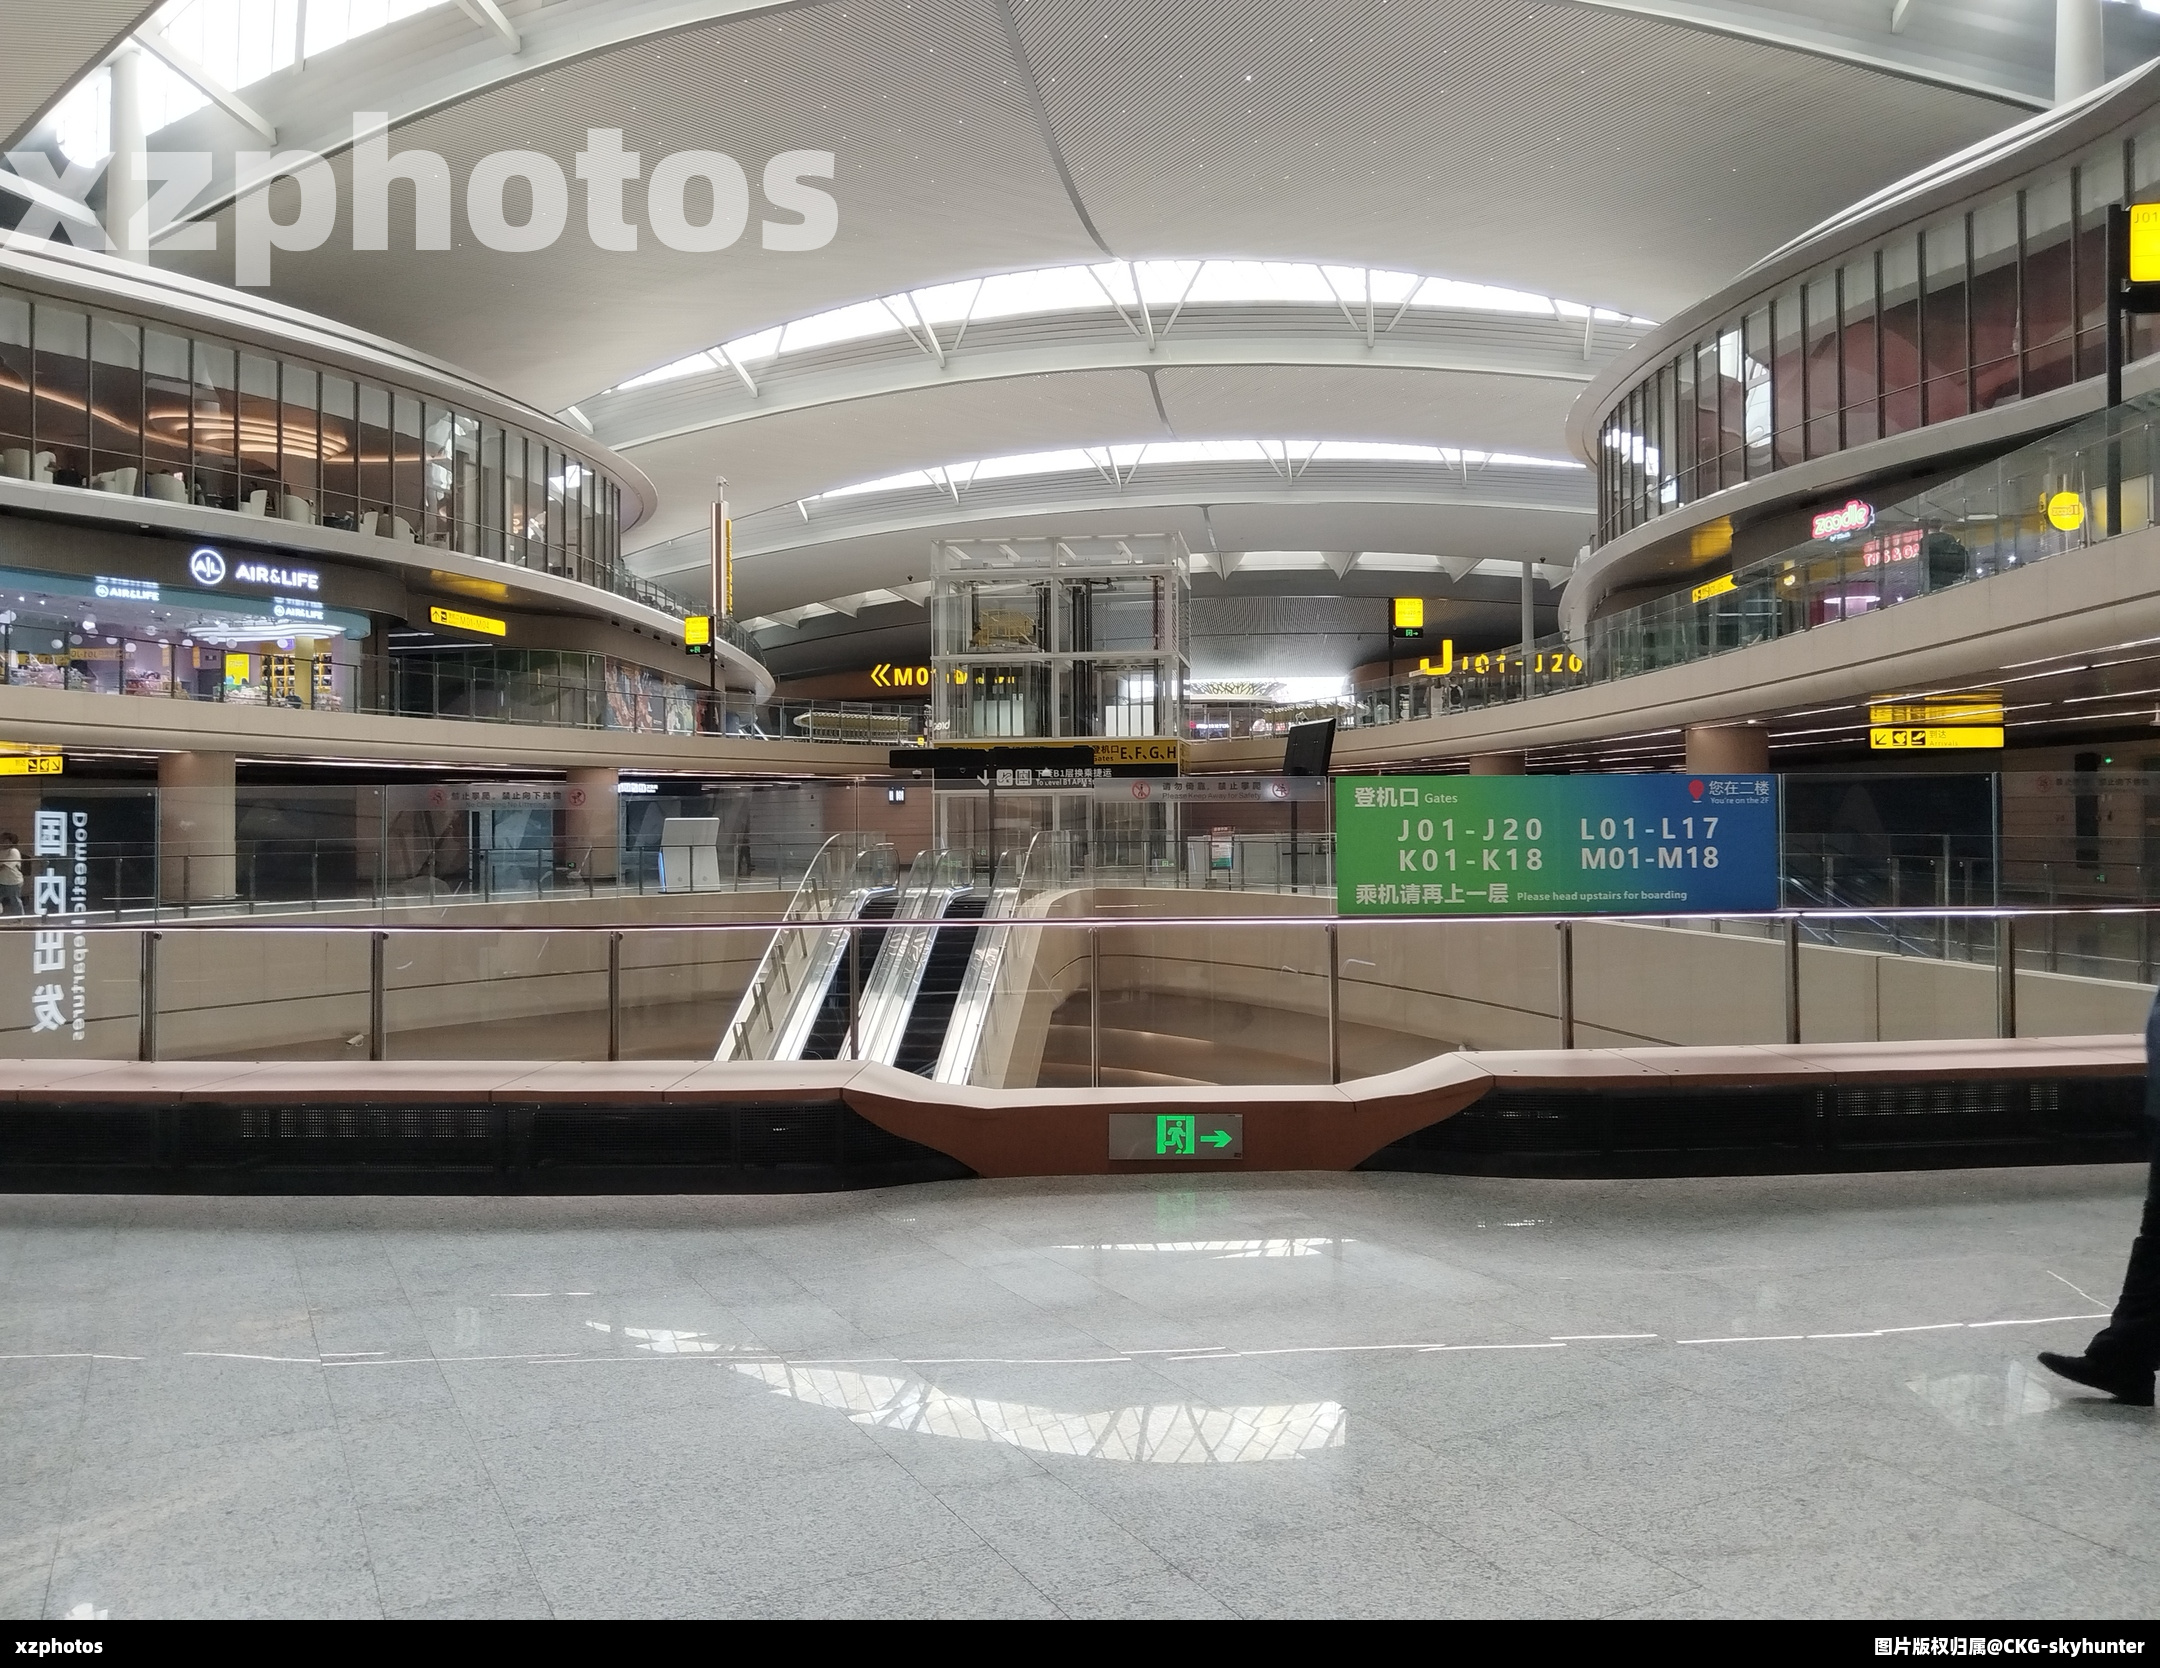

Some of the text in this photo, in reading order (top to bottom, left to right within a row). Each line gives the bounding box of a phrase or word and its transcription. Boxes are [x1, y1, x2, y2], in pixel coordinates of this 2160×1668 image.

[1814, 504, 1867, 535] zoodle
[235, 564, 319, 590] AIR&LIFE
[109, 587, 160, 602] AIR&LIFE
[284, 607, 324, 621] AIR&LIFE
[1419, 639, 1453, 676] J
[1929, 730, 1947, 739] 到达
[1035, 768, 1112, 778] 下B1层换乘捷运
[1188, 793, 1207, 801] Keep
[1208, 793, 1228, 801] Away
[1238, 793, 1262, 801] Safety
[1354, 787, 1419, 808] 登机口
[1424, 793, 1458, 804] Gates
[1709, 780, 1770, 796] 您在二楼
[1397, 818, 1543, 842] J01-J20
[1581, 817, 1719, 840] L01-L17
[1399, 848, 1543, 872] K01-K18
[1581, 846, 1719, 870] M01-M18
[1356, 883, 1509, 905] 乘机请再上一层
[1517, 890, 1688, 902] Please head upstairs for boarding
